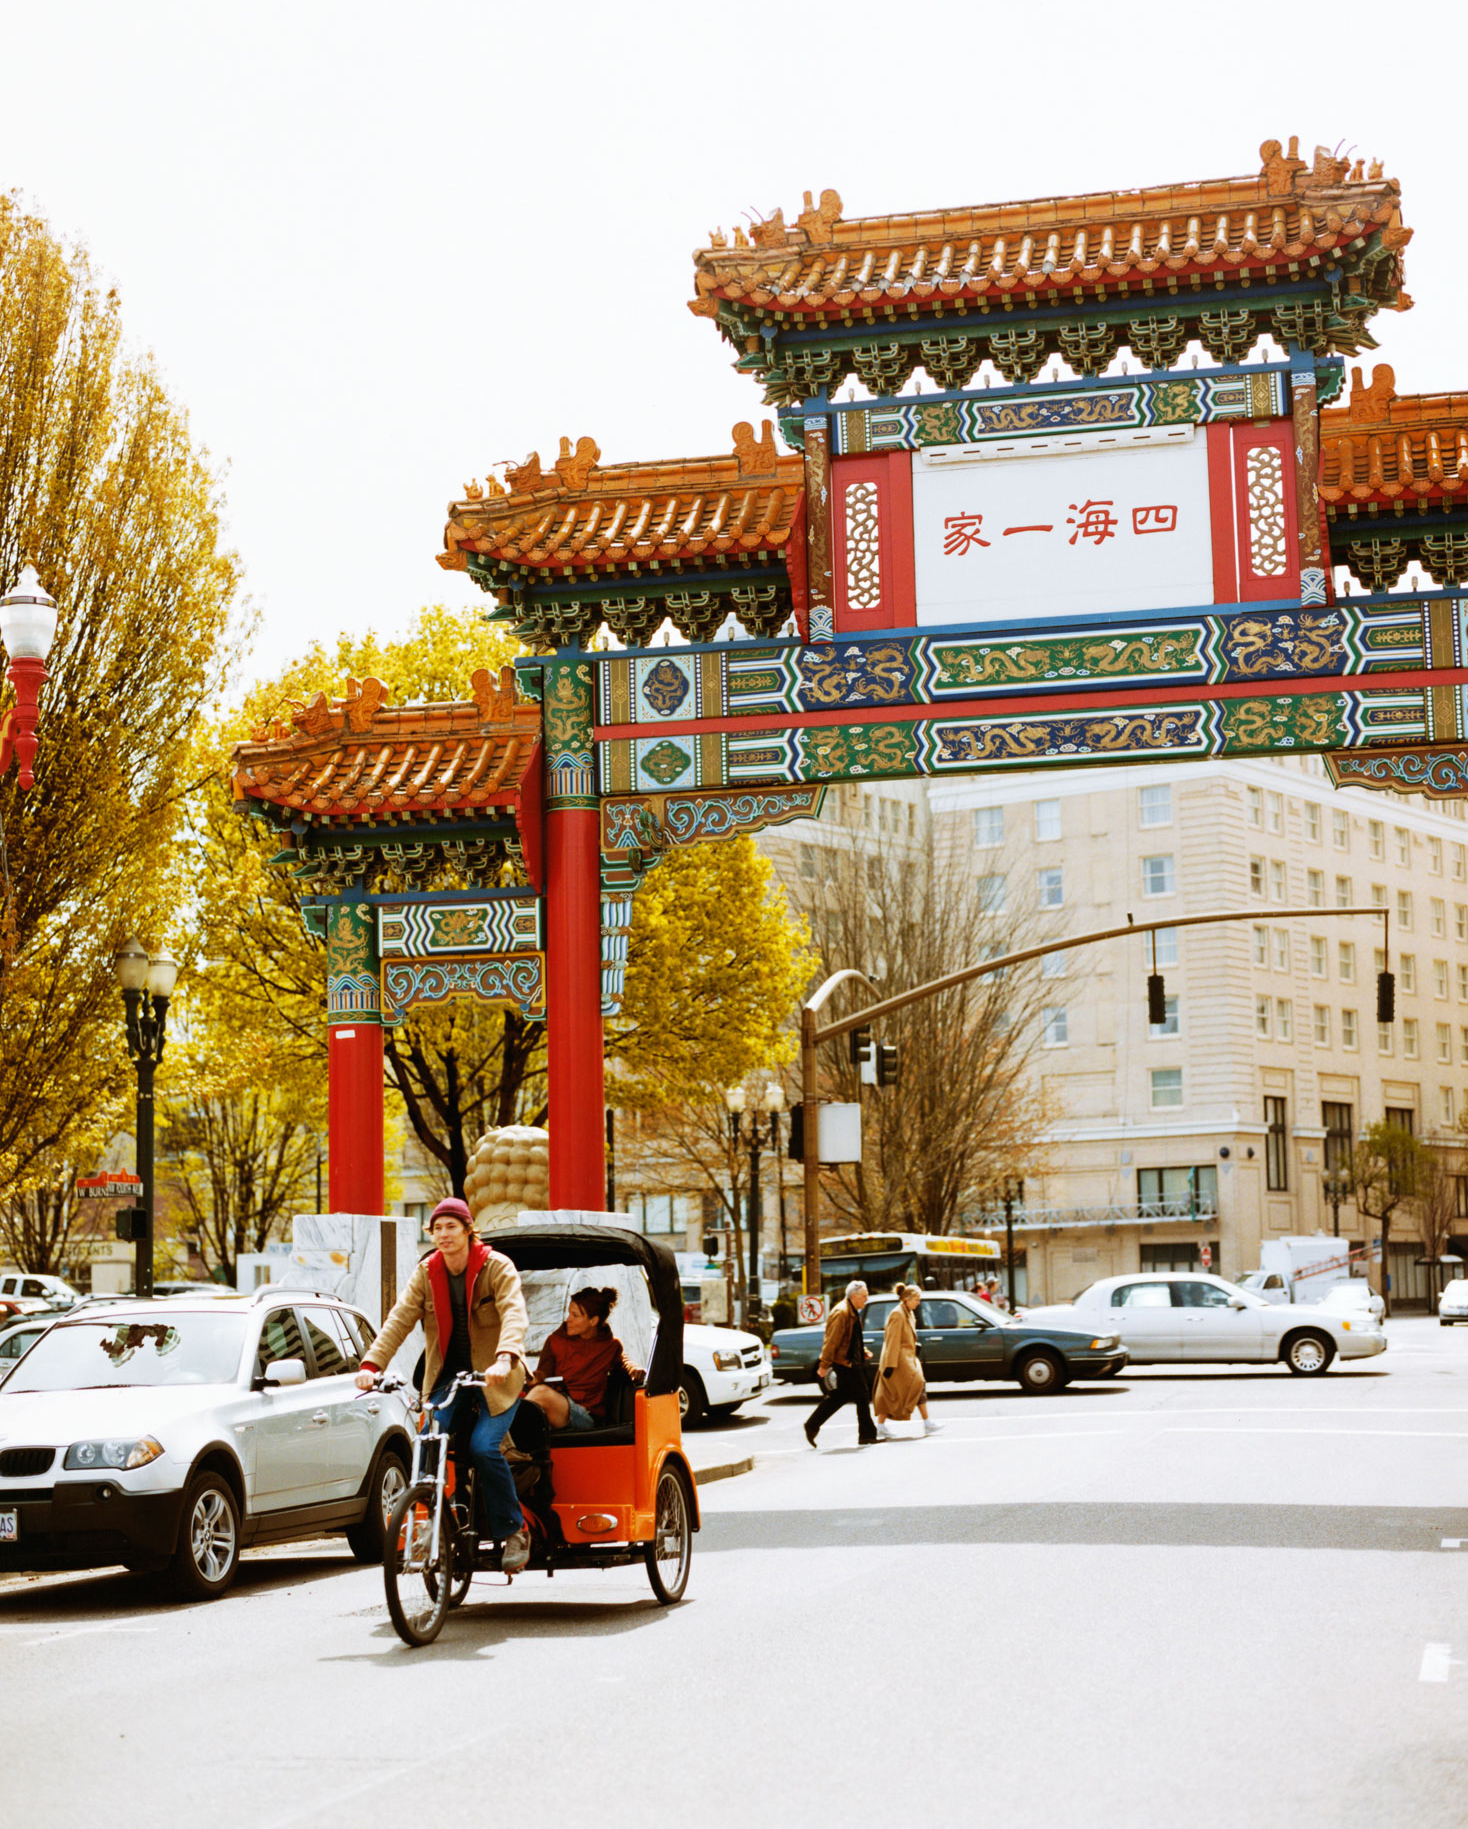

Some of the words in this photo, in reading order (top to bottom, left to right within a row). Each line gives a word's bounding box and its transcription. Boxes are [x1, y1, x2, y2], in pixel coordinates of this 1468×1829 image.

[79, 1187, 86, 1198] W
[89, 1186, 108, 1198] BURN
[0, 1517, 14, 1533] AS
